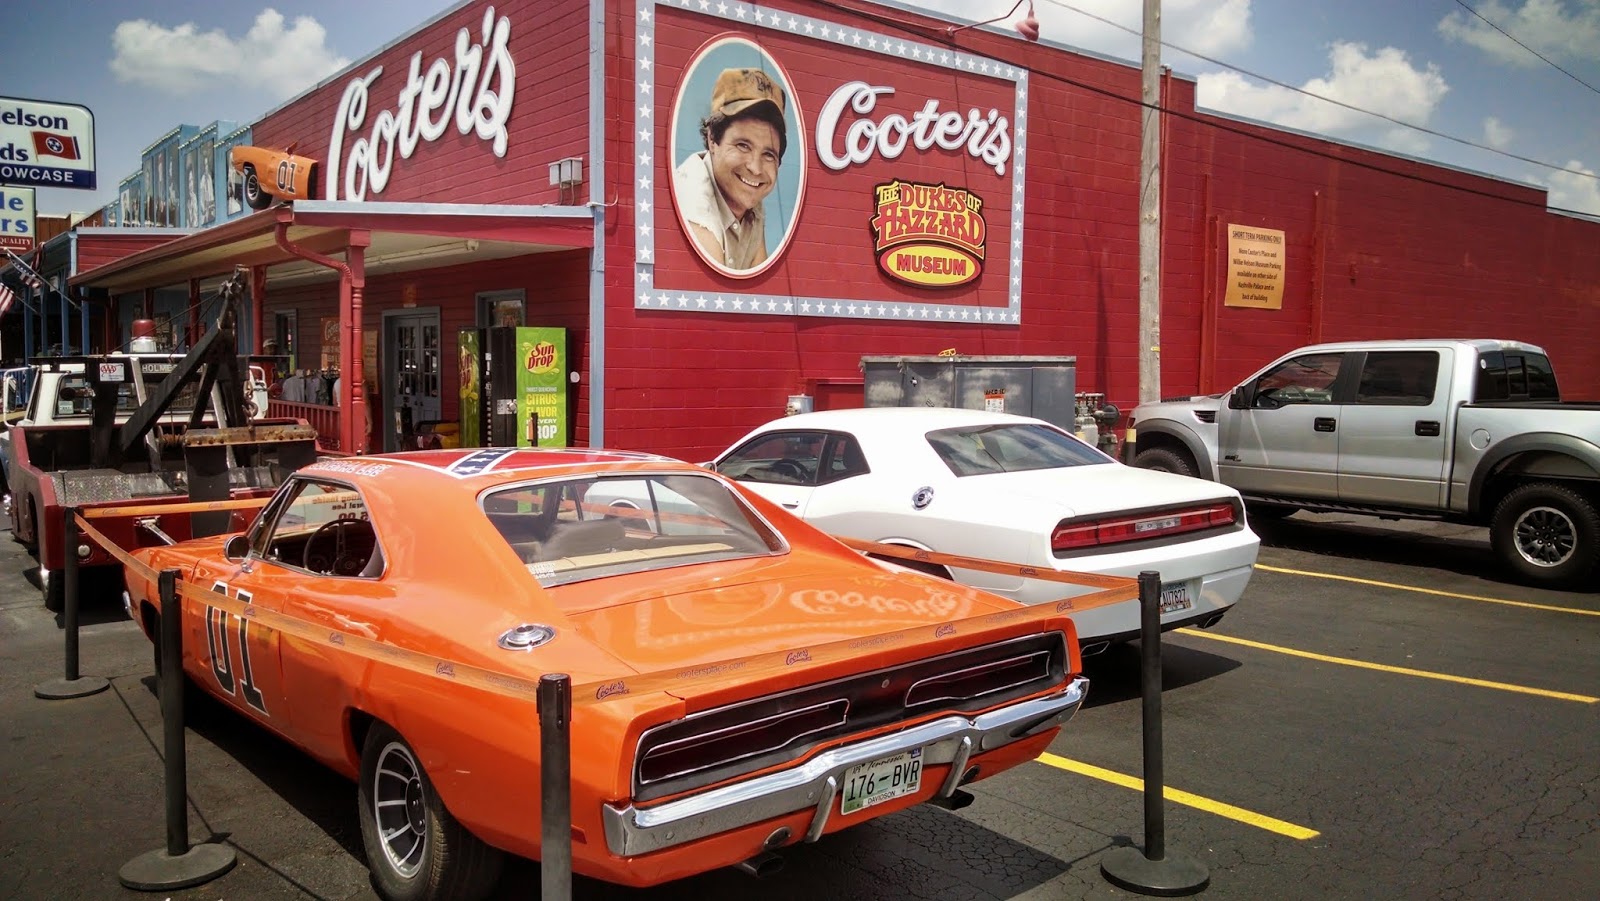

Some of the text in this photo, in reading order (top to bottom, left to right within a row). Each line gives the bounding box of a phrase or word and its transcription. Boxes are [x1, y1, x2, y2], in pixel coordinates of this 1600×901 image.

[326, 6, 515, 202] Cooter's
[0, 108, 69, 131] elson
[815, 81, 1011, 176] Cooter's
[0, 142, 30, 162] ds
[1, 166, 74, 183] OWCASE
[277, 160, 297, 195] 01
[0, 190, 24, 212] le
[876, 181, 982, 213] THE DUKES OF
[0, 218, 30, 233] rs
[872, 200, 986, 250] HAZZARD
[896, 253, 967, 277] MUSEUM
[531, 343, 555, 357] Sun
[527, 355, 553, 370] Drop
[526, 393, 557, 405] CITRUS
[204, 579, 271, 717] 01
[847, 760, 920, 802] 176-BVR
[867, 790, 896, 805] DAVIDSON
